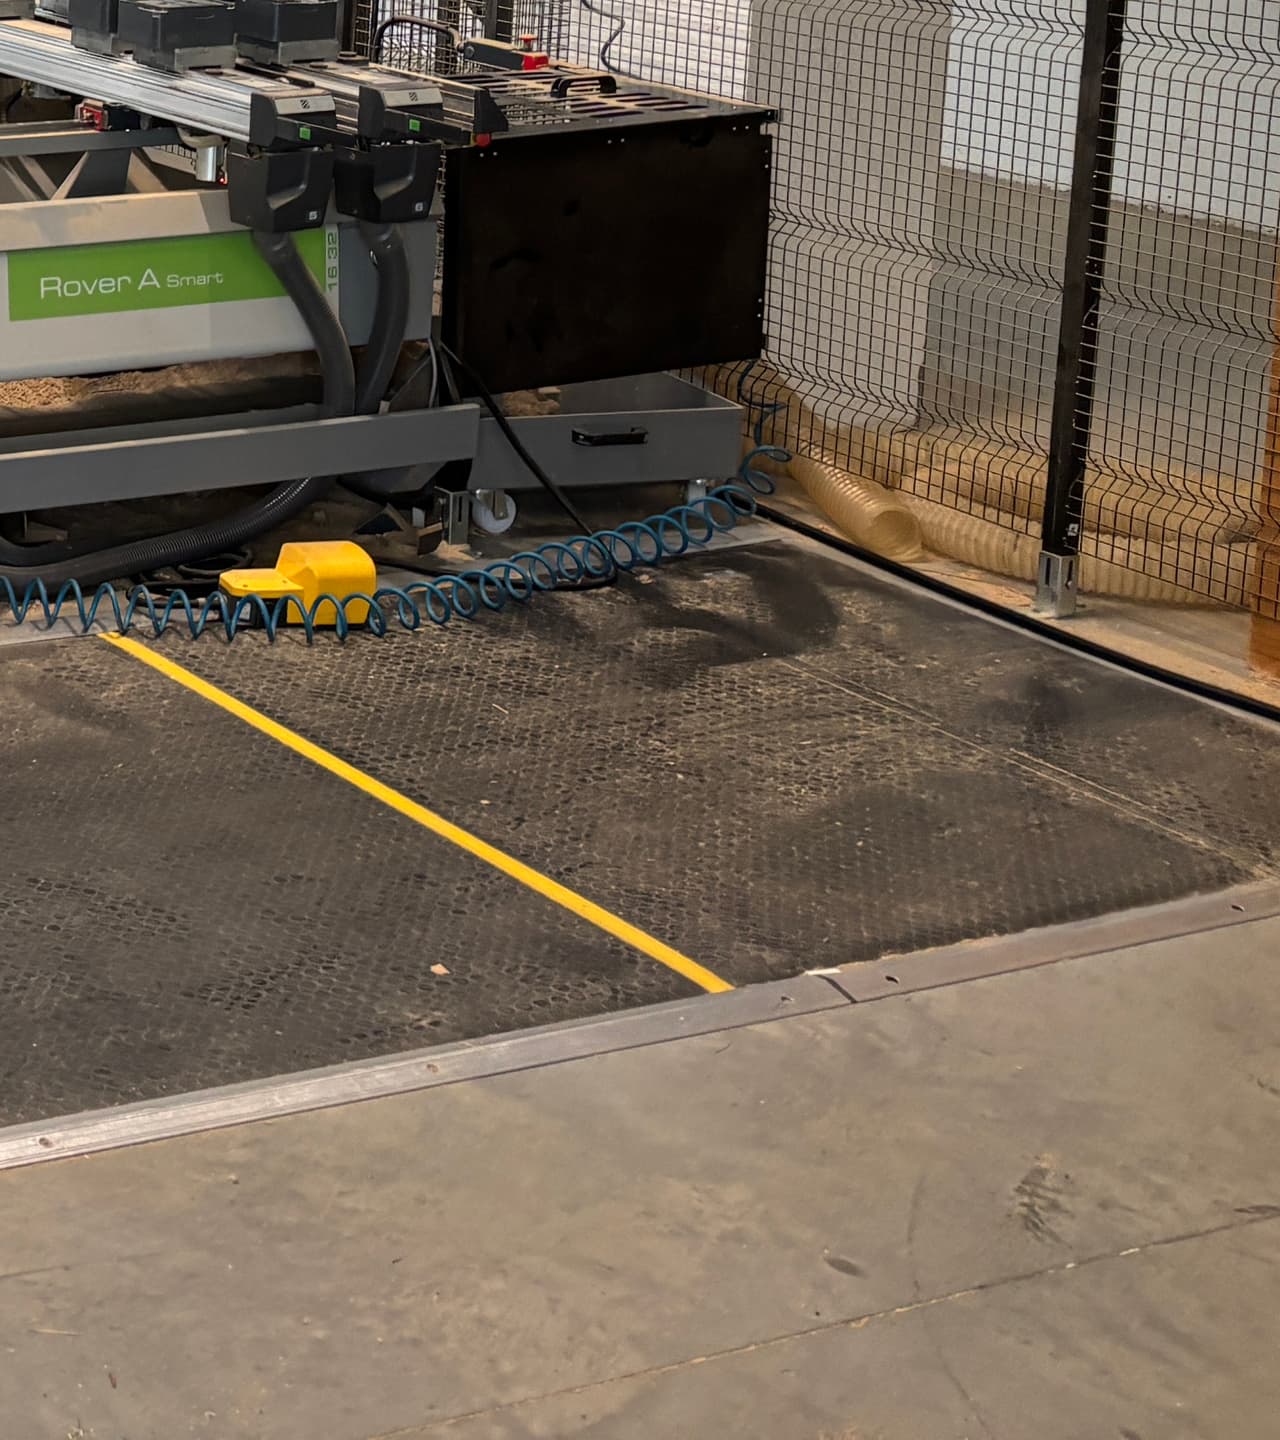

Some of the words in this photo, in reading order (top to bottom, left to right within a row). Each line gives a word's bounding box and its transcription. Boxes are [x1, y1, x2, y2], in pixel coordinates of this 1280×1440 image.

[327, 232, 337, 260] 32
[40, 275, 131, 299] Rover
[138, 267, 161, 290] A
[167, 272, 223, 288] Smart
